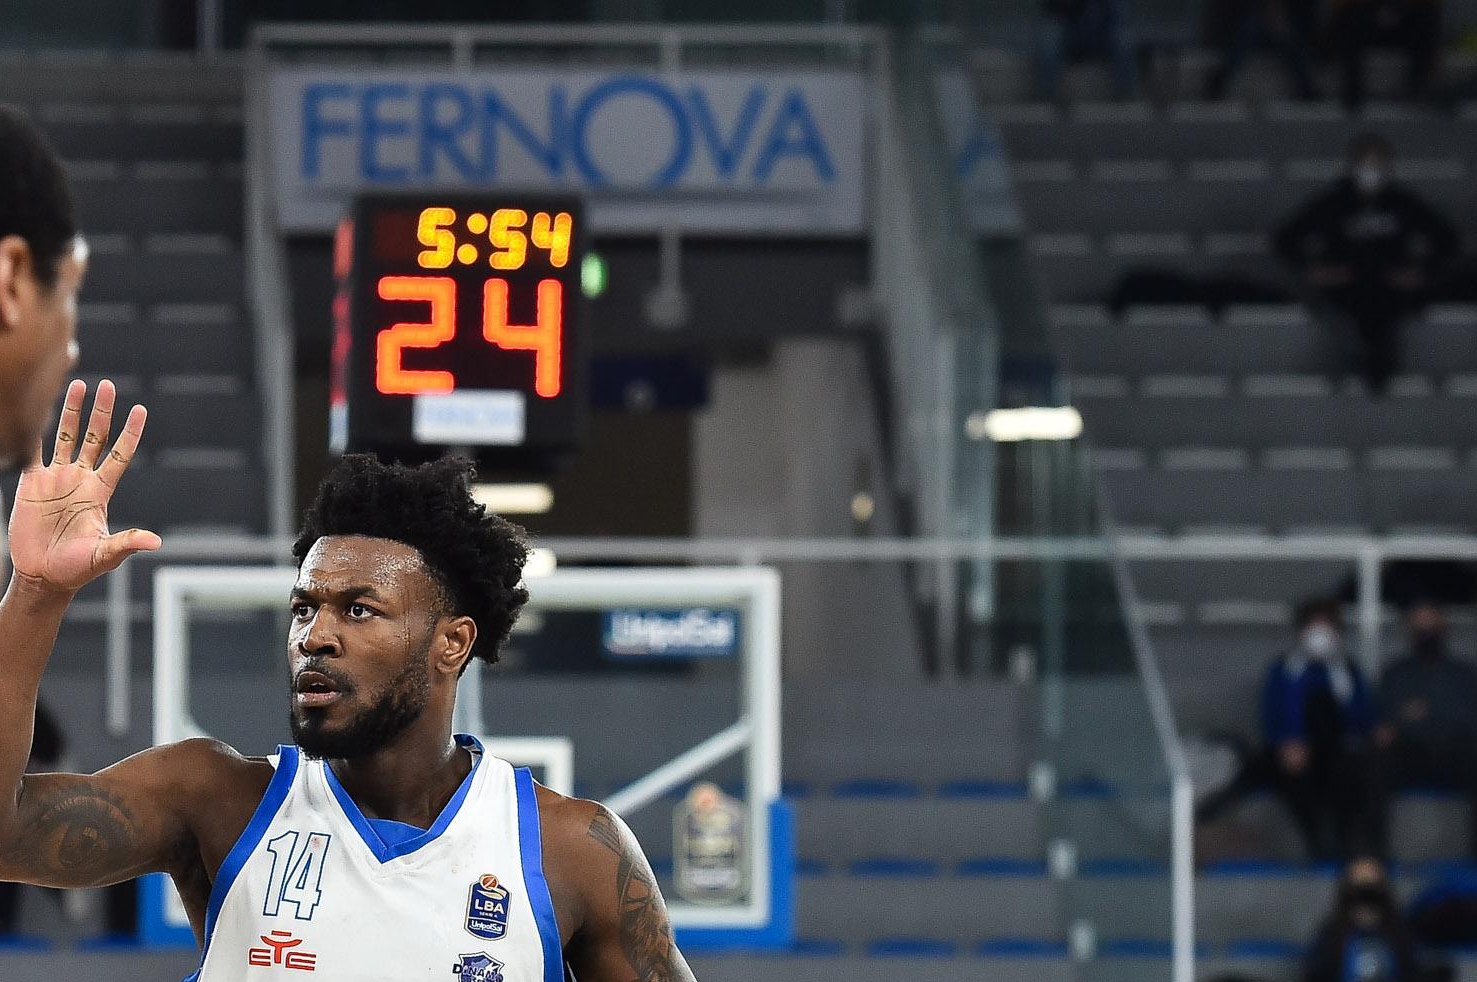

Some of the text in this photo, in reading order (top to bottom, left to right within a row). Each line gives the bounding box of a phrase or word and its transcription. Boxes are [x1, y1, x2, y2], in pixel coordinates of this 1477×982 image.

[300, 75, 834, 188] FERNOVA
[417, 206, 572, 270] 5:54
[375, 275, 563, 398] 24
[262, 830, 331, 921] 14
[474, 898, 505, 915] LBA
